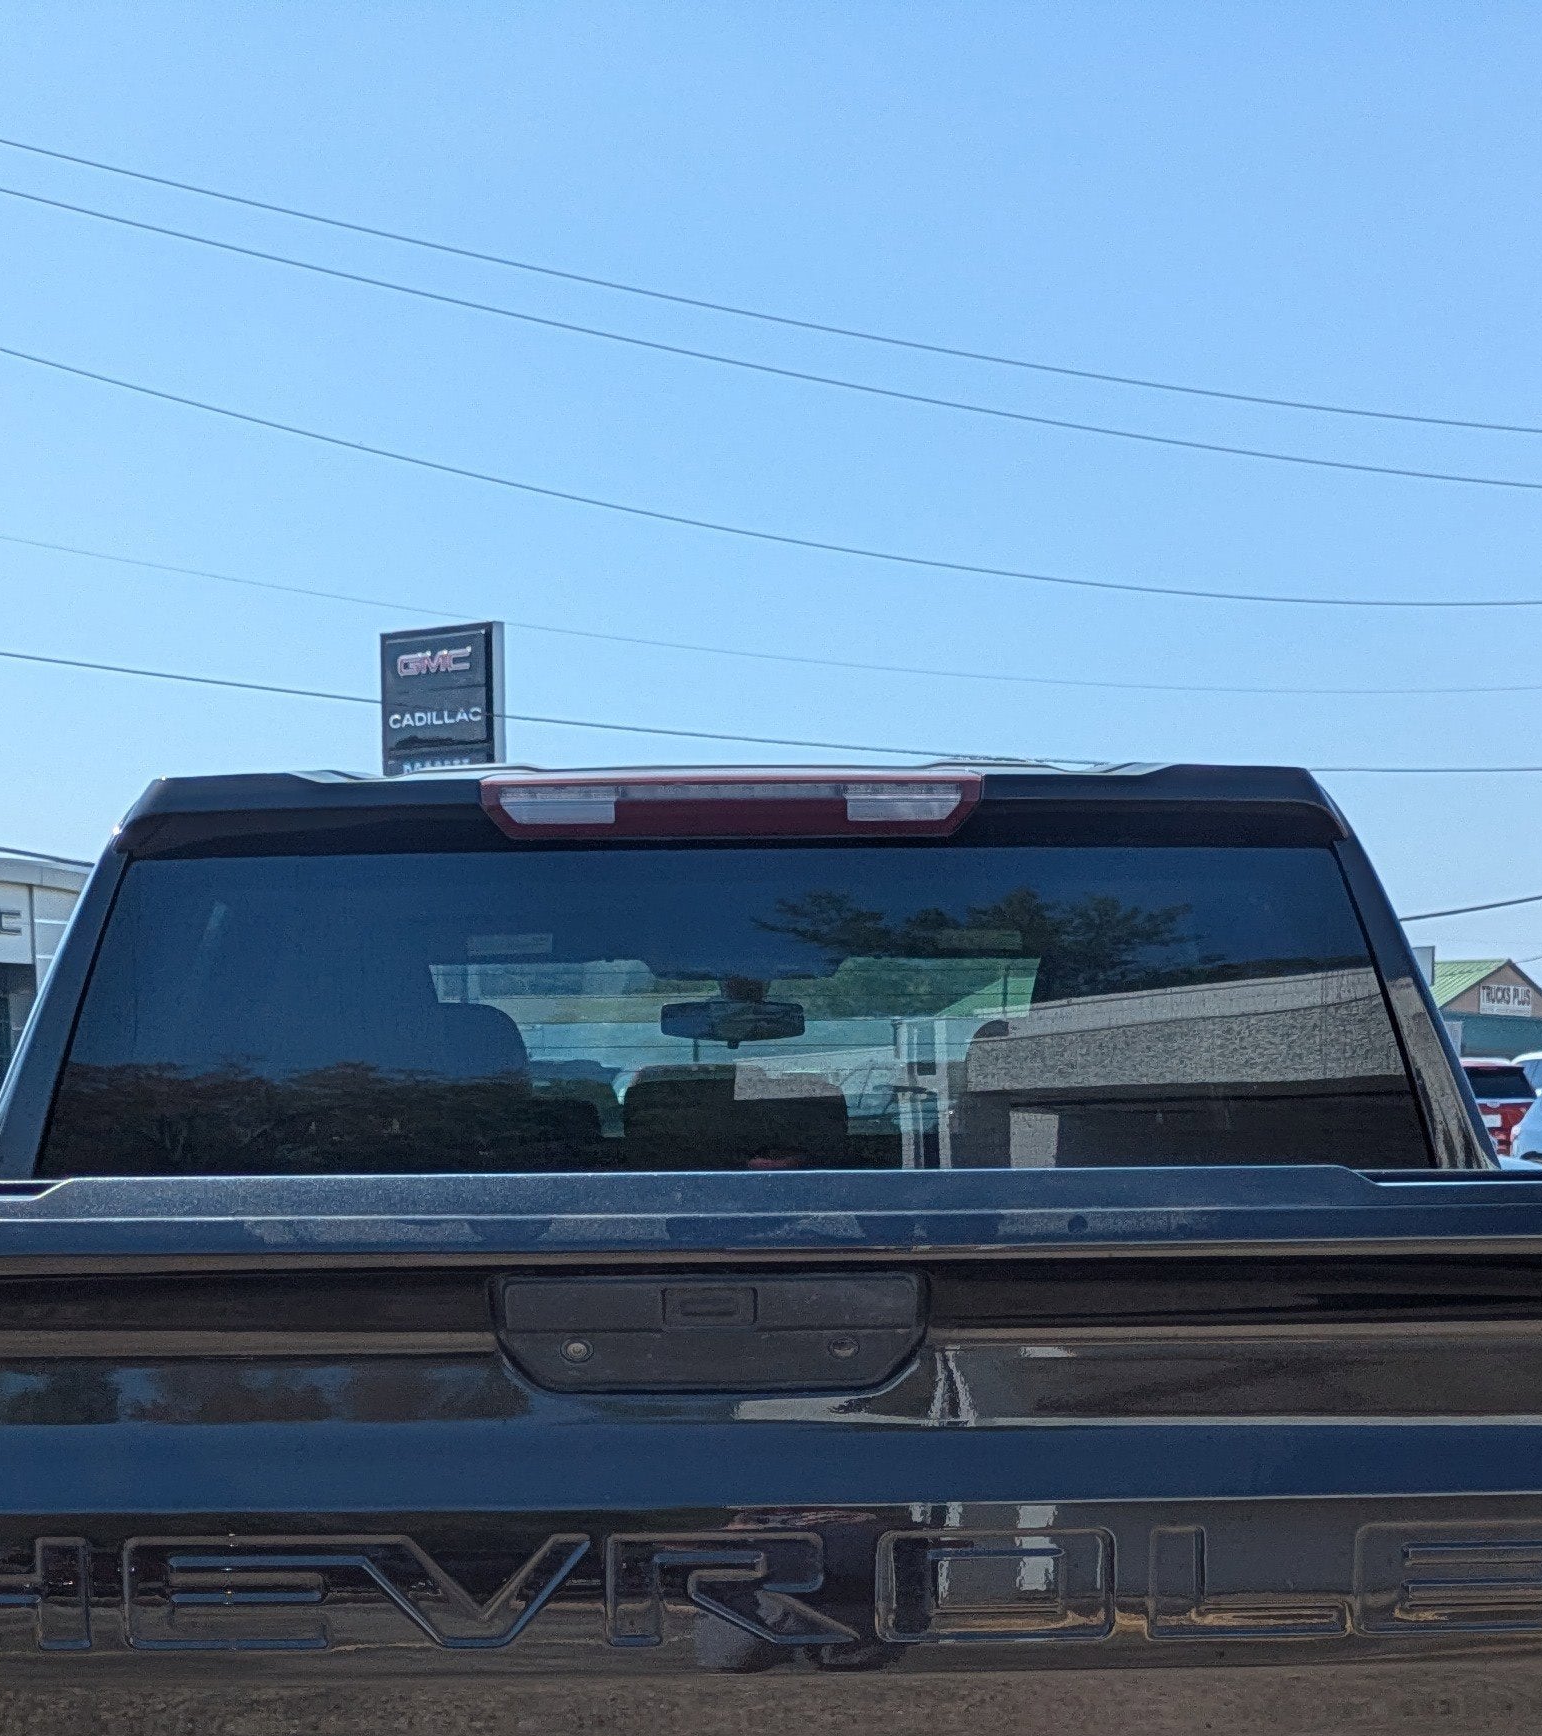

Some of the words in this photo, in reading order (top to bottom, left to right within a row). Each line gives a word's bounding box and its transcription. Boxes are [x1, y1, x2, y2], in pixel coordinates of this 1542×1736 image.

[397, 645, 472, 677] GMC
[389, 707, 482, 730] CADILLAC
[1481, 985, 1511, 1005] TRUCKS
[1513, 986, 1531, 1007] PLUS
